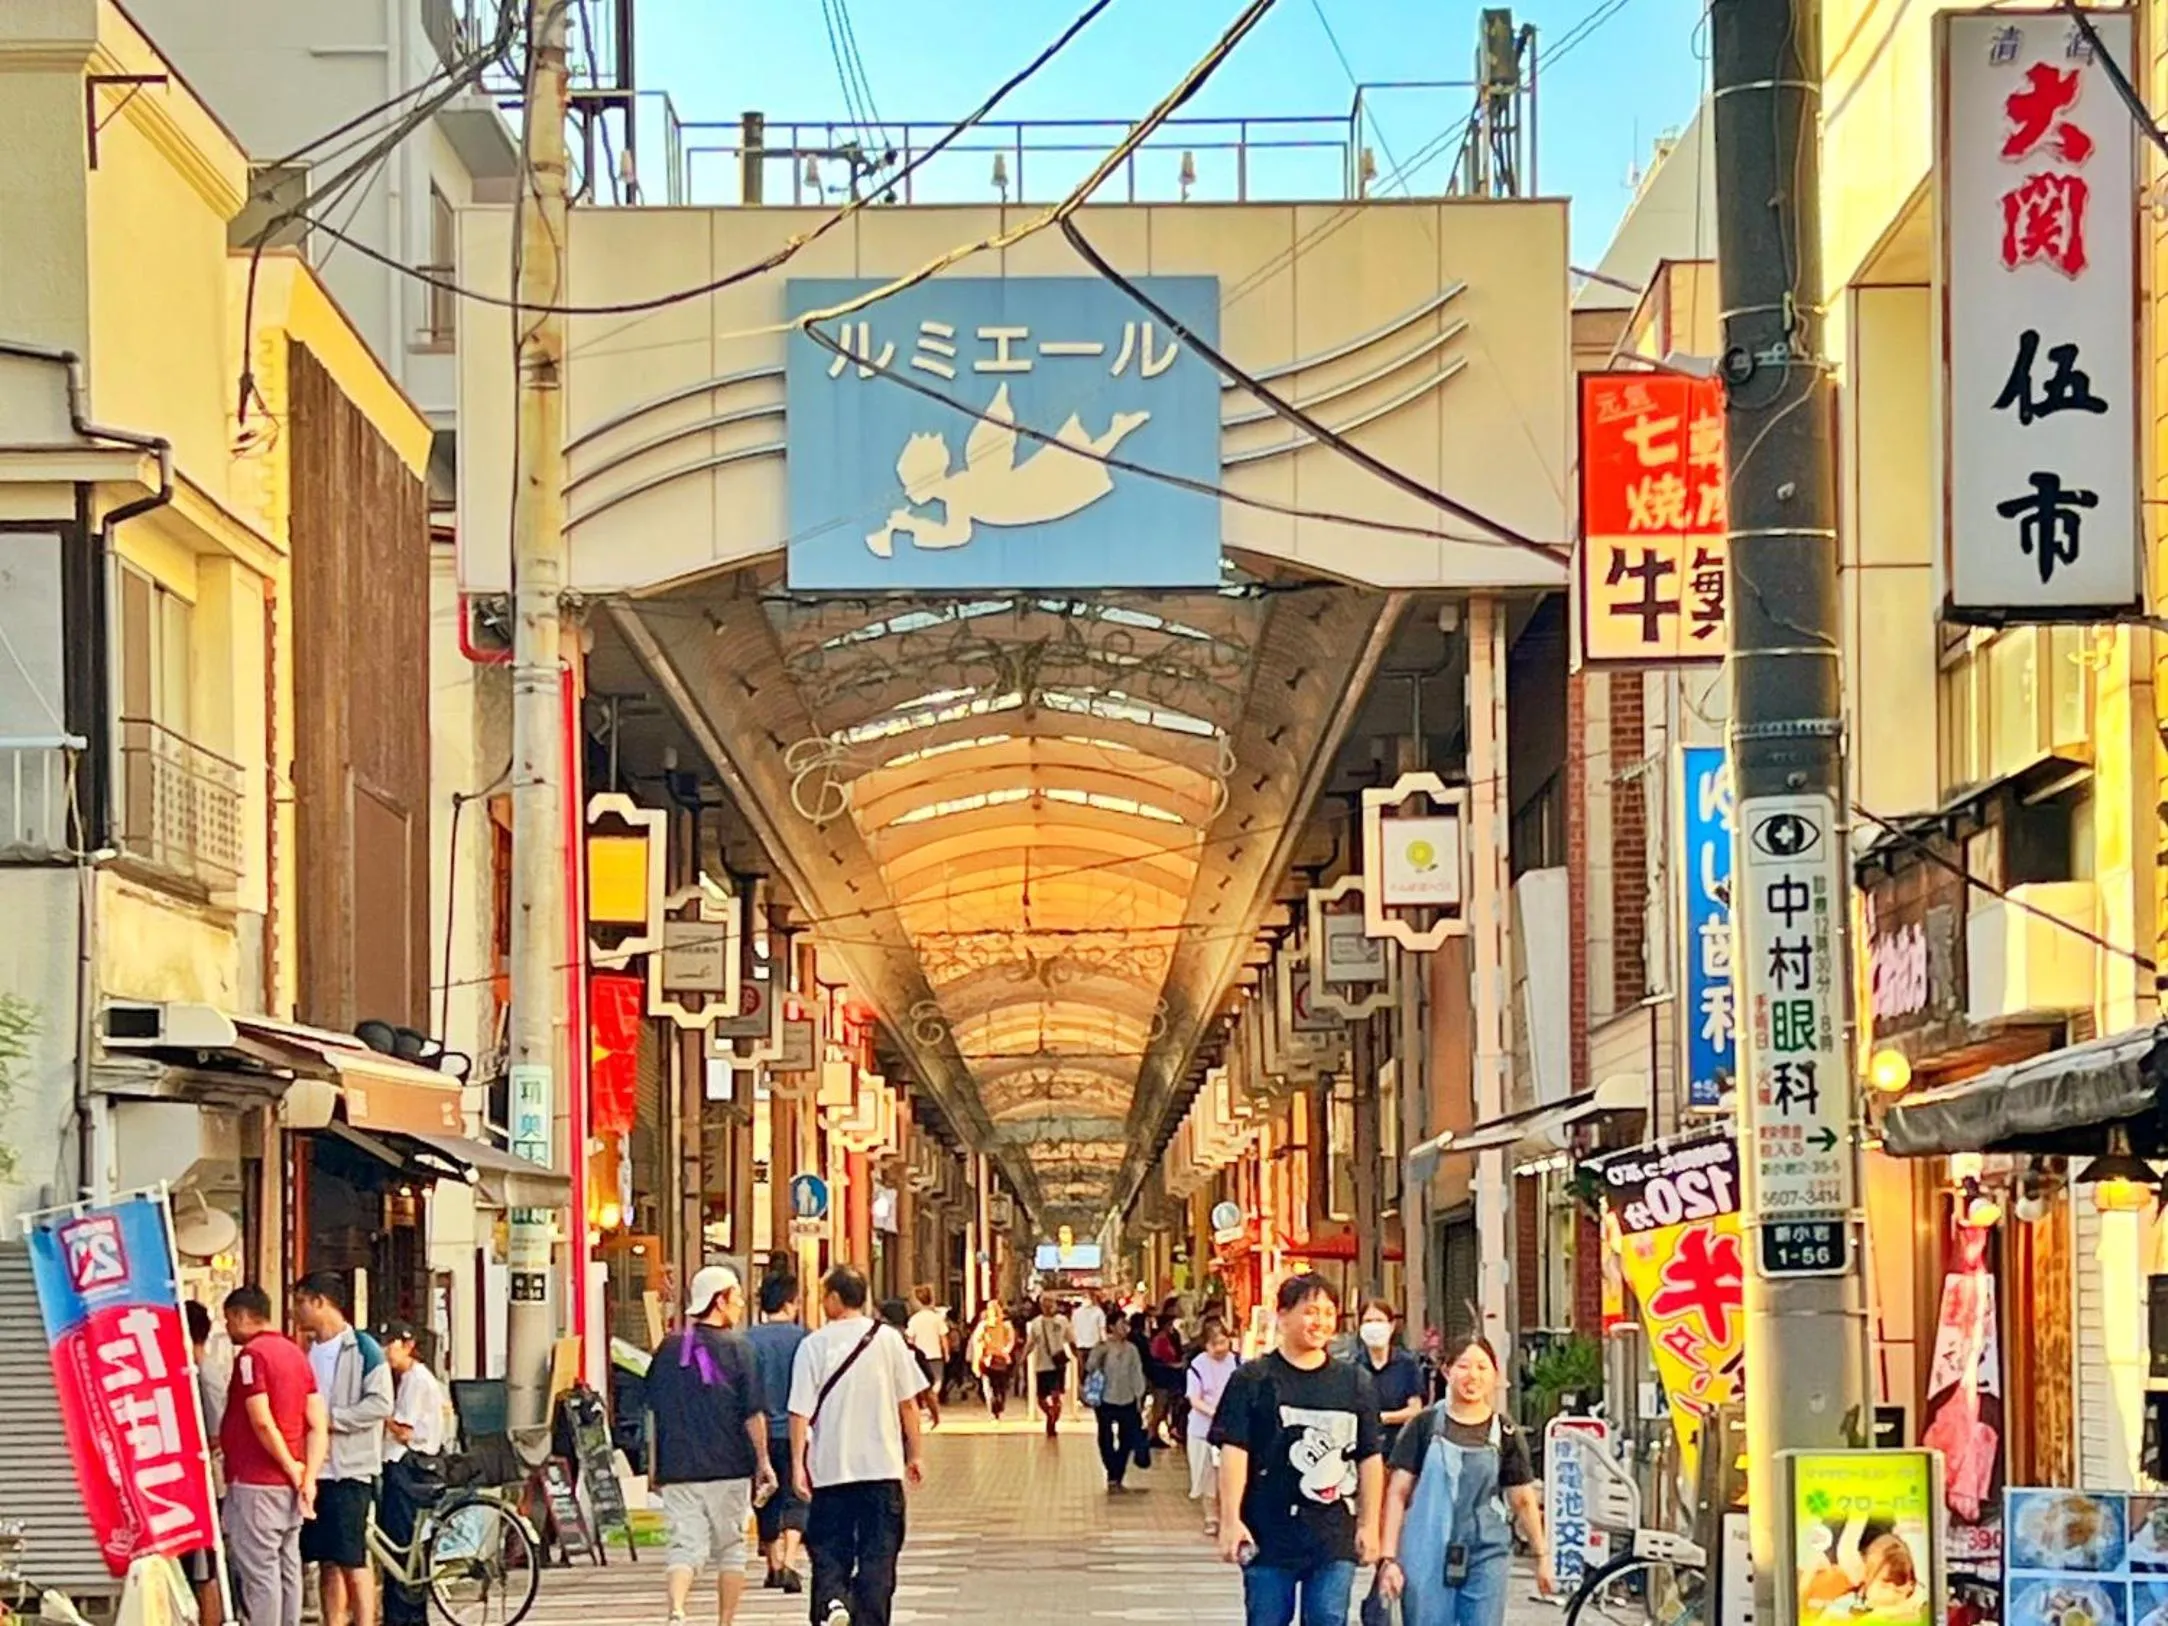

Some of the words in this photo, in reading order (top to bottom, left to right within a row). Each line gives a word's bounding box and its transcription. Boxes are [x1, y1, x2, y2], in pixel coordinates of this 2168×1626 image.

[2000, 62, 2093, 280] 大関
[828, 321, 1179, 379] ルミエール
[1991, 329, 2108, 583] 伍市
[1767, 873, 1819, 1116] 中村眼科
[1778, 1246, 1830, 1265] 1-56
